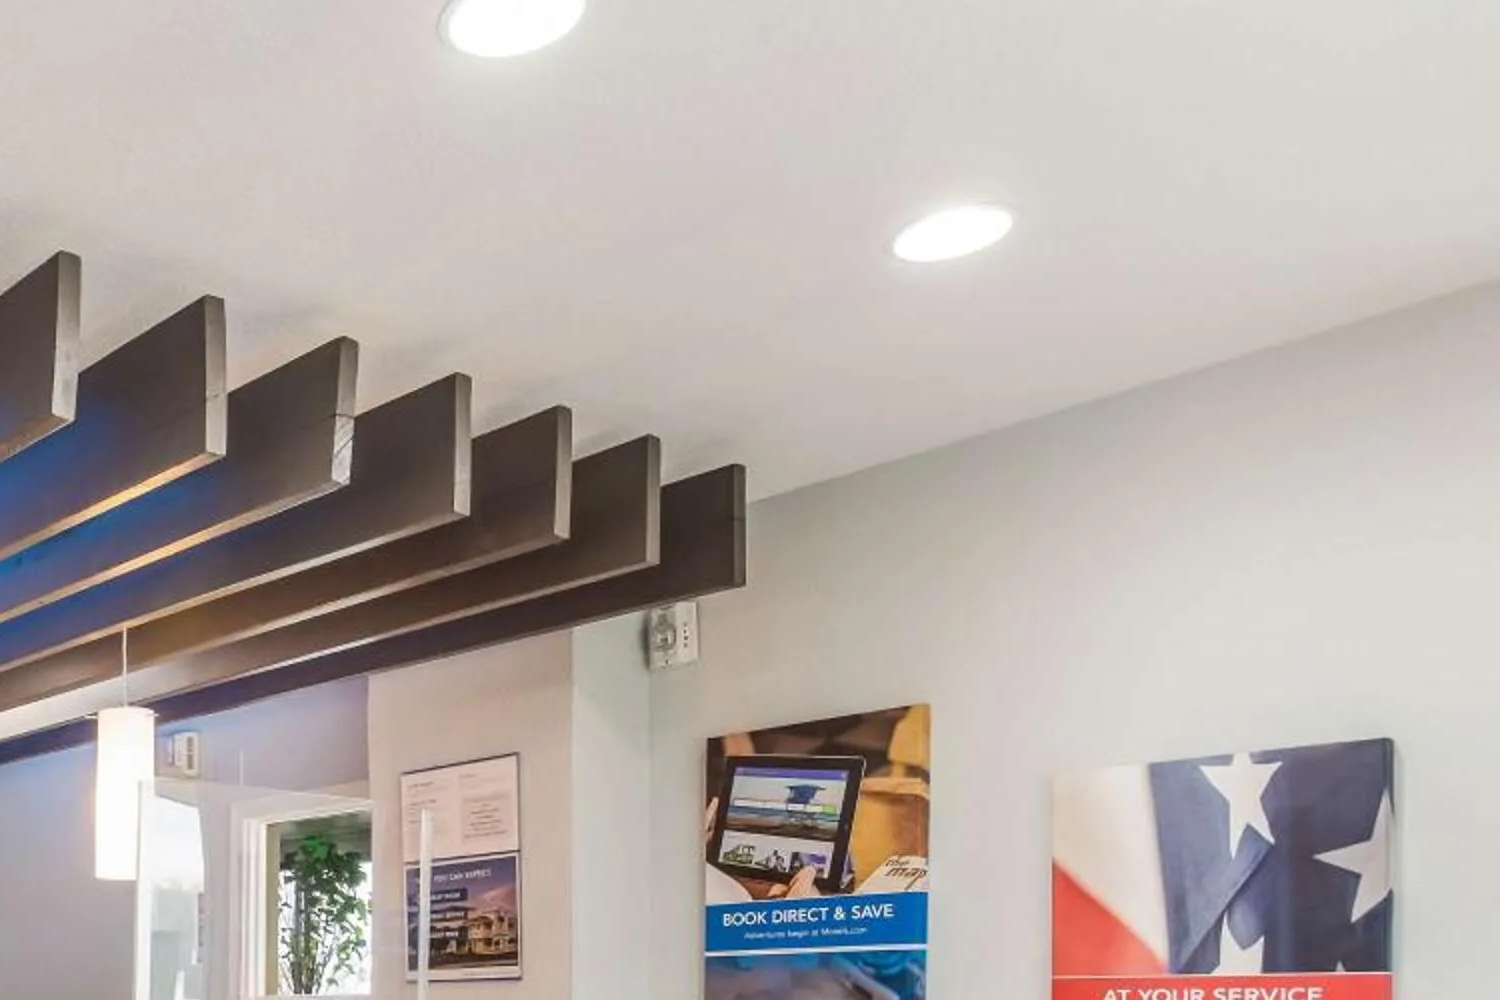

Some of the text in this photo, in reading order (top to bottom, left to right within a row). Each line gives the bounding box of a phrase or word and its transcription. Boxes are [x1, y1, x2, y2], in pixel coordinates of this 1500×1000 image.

[722, 903, 895, 927] BOOK DIRECT & SAVE
